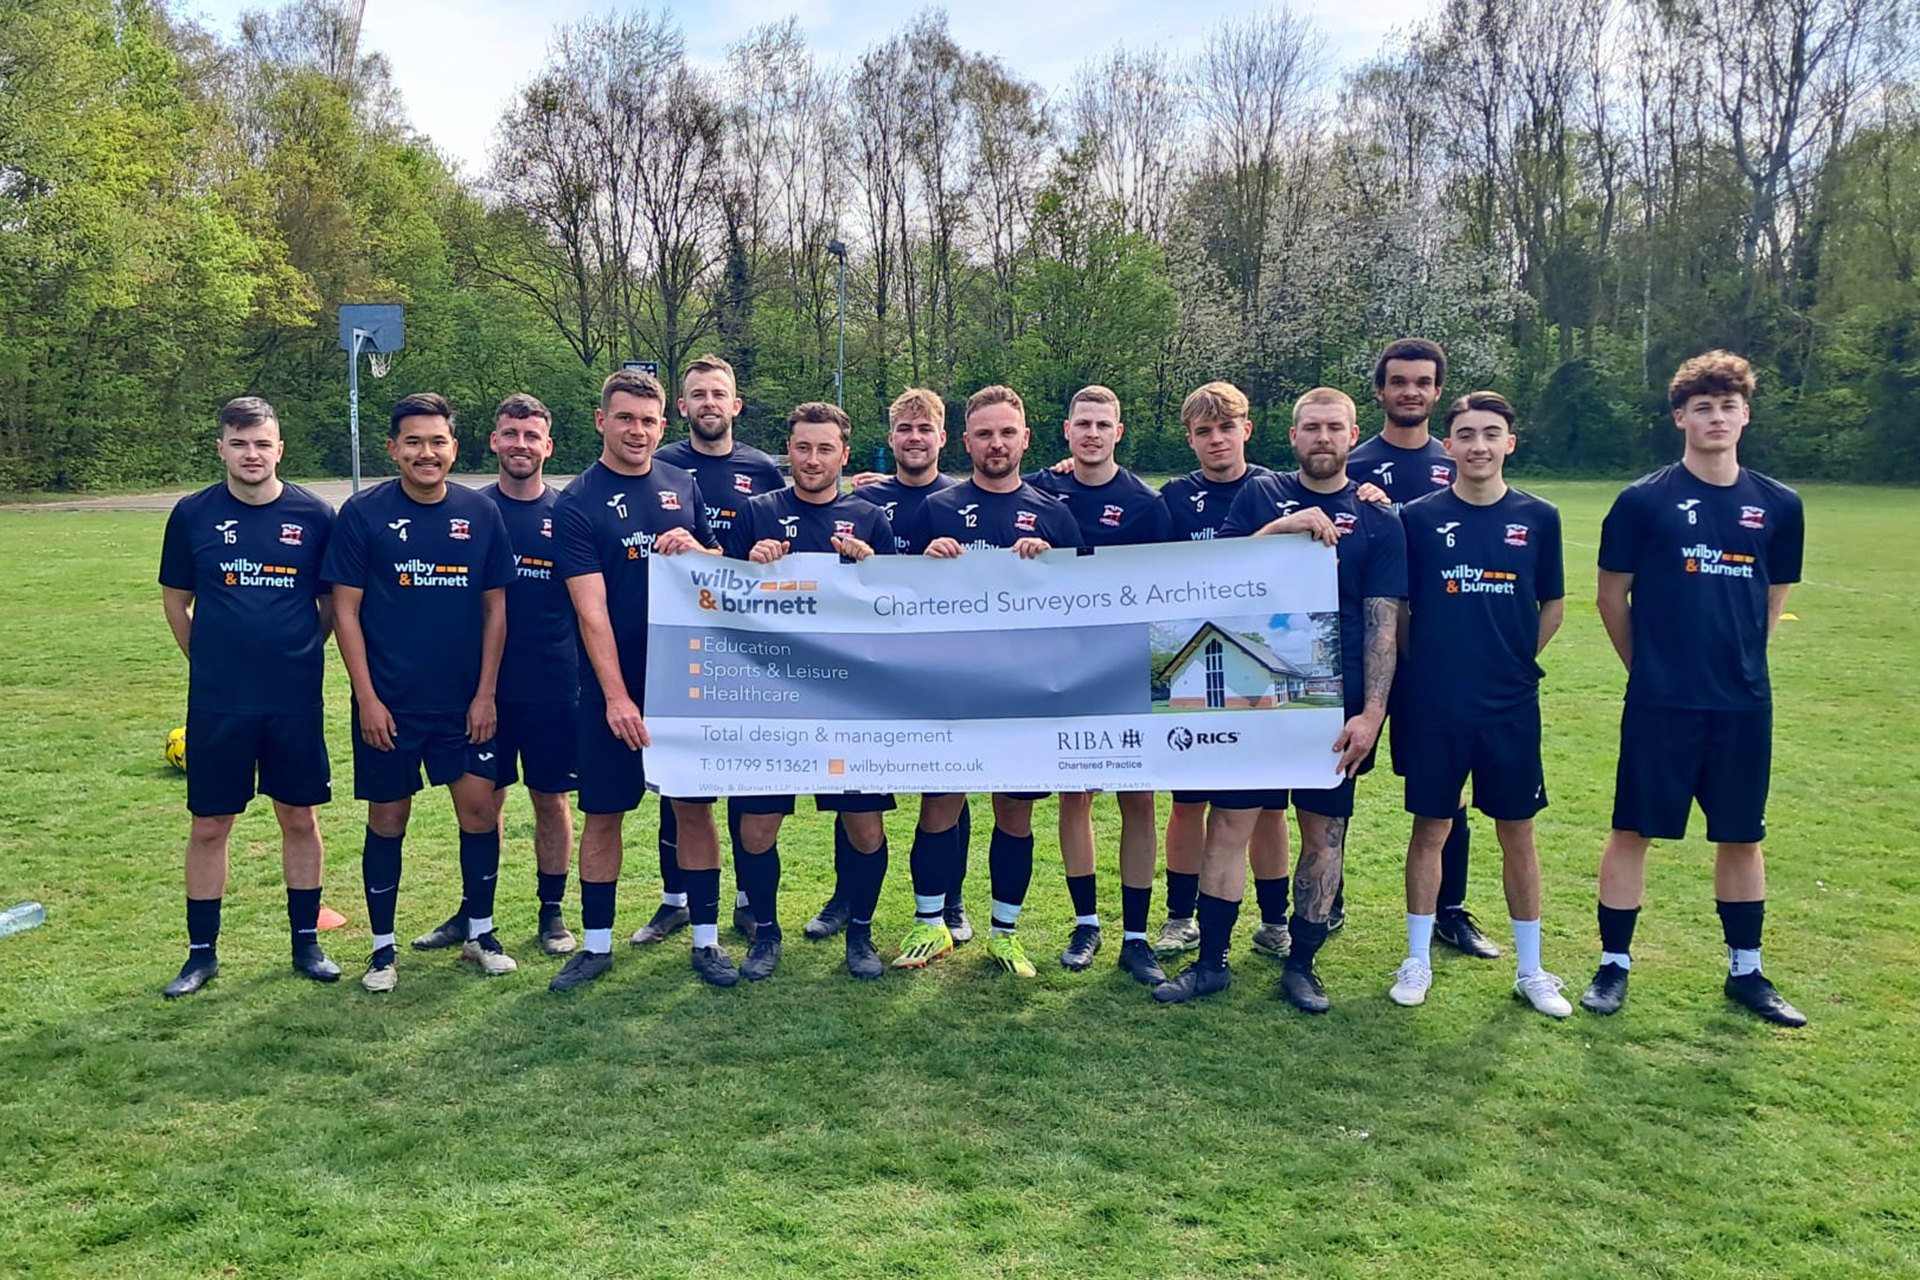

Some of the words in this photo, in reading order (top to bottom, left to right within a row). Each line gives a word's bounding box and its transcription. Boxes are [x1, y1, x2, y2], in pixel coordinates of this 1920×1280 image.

[1382, 471, 1393, 485] 11
[616, 504, 628, 519] 17
[1196, 500, 1205, 513] 9
[965, 514, 978, 528] 12
[1688, 510, 1697, 525] 8
[224, 530, 238, 544] 15
[399, 528, 408, 541] 4
[785, 525, 798, 538] 10
[1446, 533, 1456, 548] 6
[1682, 544, 1723, 563] wilby
[219, 558, 263, 576] wilby
[394, 559, 436, 576] wilby
[1441, 564, 1484, 581] wilby
[1685, 558, 1698, 573] &
[1701, 559, 1753, 578] burnett
[225, 572, 238, 585] &
[240, 572, 295, 588] burnett
[398, 573, 412, 586] &
[413, 573, 469, 587] burnett
[691, 568, 760, 596] wilby
[1446, 580, 1459, 593] &
[1461, 579, 1515, 595] burnett
[699, 589, 718, 611] &
[722, 591, 818, 615] burnett
[874, 591, 990, 616] Chartered
[998, 591, 1112, 616] Surveyors
[1120, 585, 1138, 607] &
[1145, 581, 1267, 604] Architects
[704, 636, 791, 655] Education
[703, 660, 761, 682] Sports
[767, 662, 781, 678] &
[787, 663, 849, 679] Leisure
[703, 685, 800, 702] Healthcare
[700, 725, 743, 741] Total
[749, 725, 808, 747] design
[815, 726, 829, 742] &
[834, 729, 953, 747] management
[1058, 731, 1114, 750] RIBA
[1197, 732, 1239, 744] RICS
[700, 758, 711, 771] T:
[716, 758, 761, 771] 01799
[766, 759, 818, 772] 513621
[849, 759, 984, 775] wilbyburnett.co.uk
[1058, 760, 1103, 770] Chartered
[1106, 759, 1142, 769] Practice
[699, 783, 724, 793] Wilby
